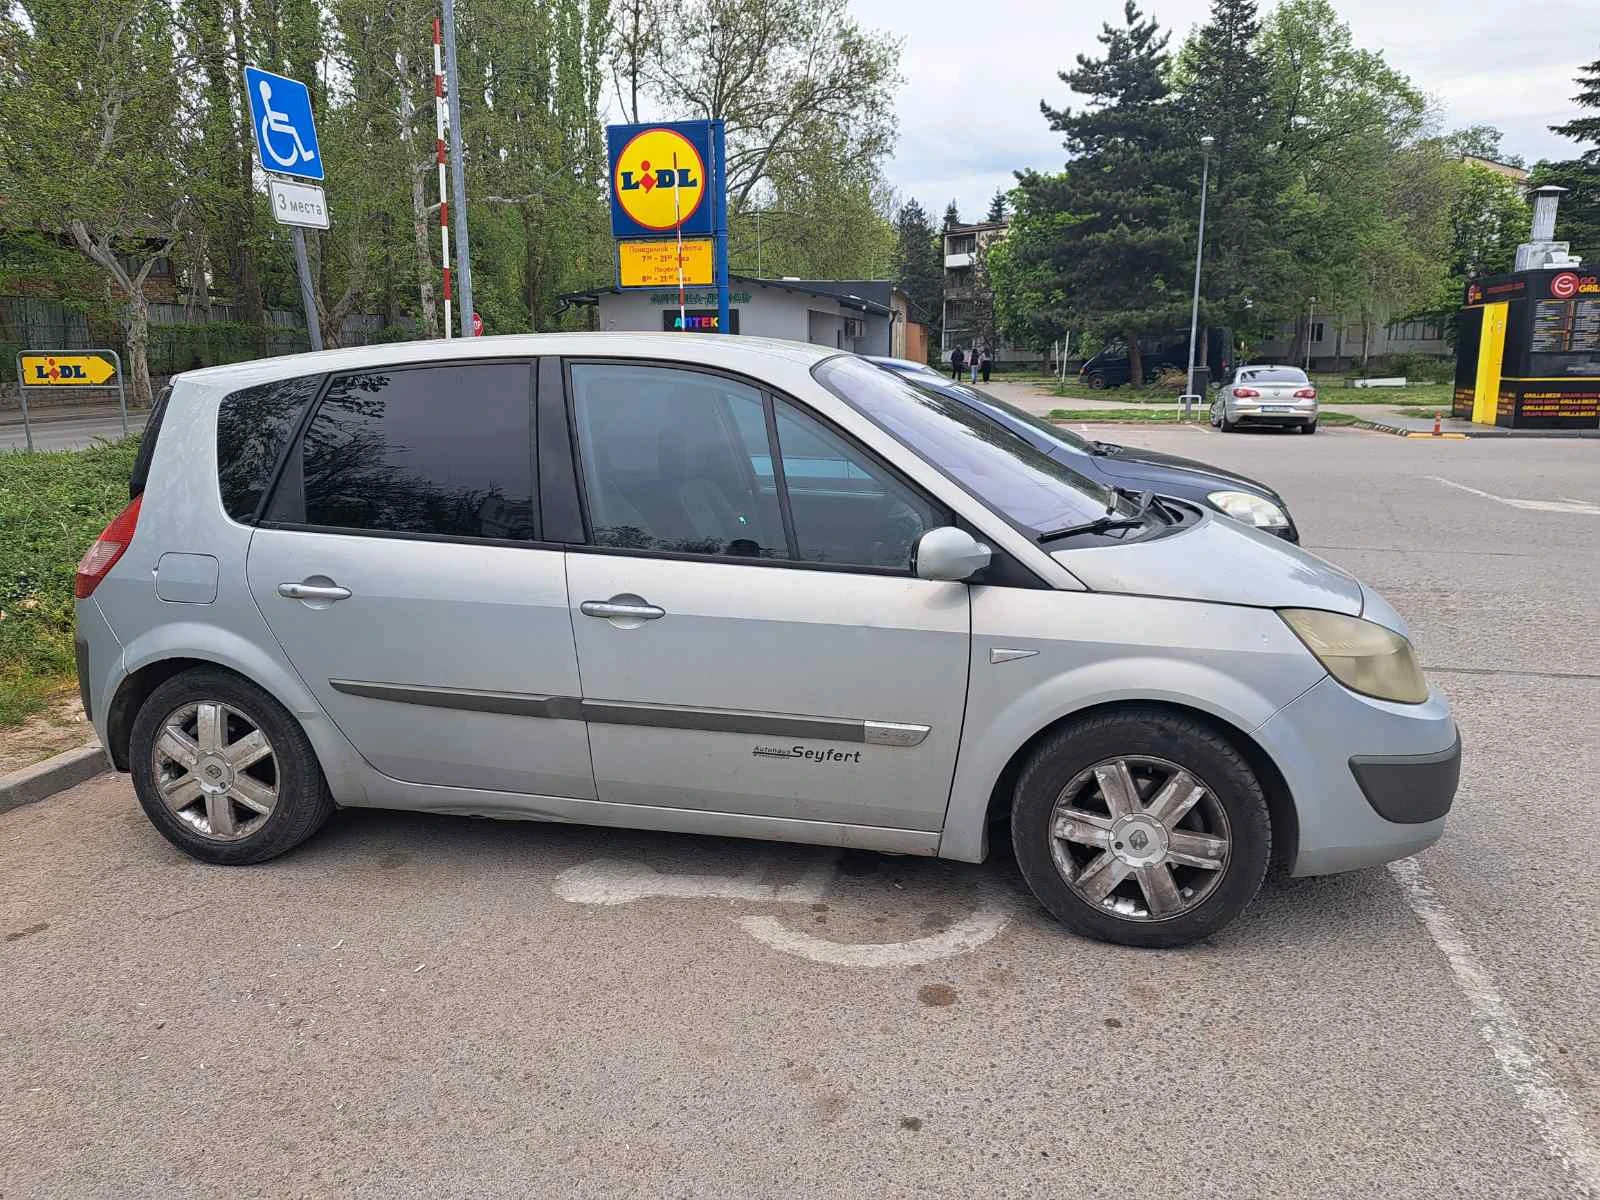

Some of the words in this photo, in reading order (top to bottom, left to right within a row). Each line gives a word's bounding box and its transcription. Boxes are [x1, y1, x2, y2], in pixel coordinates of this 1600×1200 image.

[278, 194, 286, 210] 3
[290, 202, 322, 215] места
[1579, 284, 1600, 293] GRIL
[792, 745, 862, 763] Seyfert
